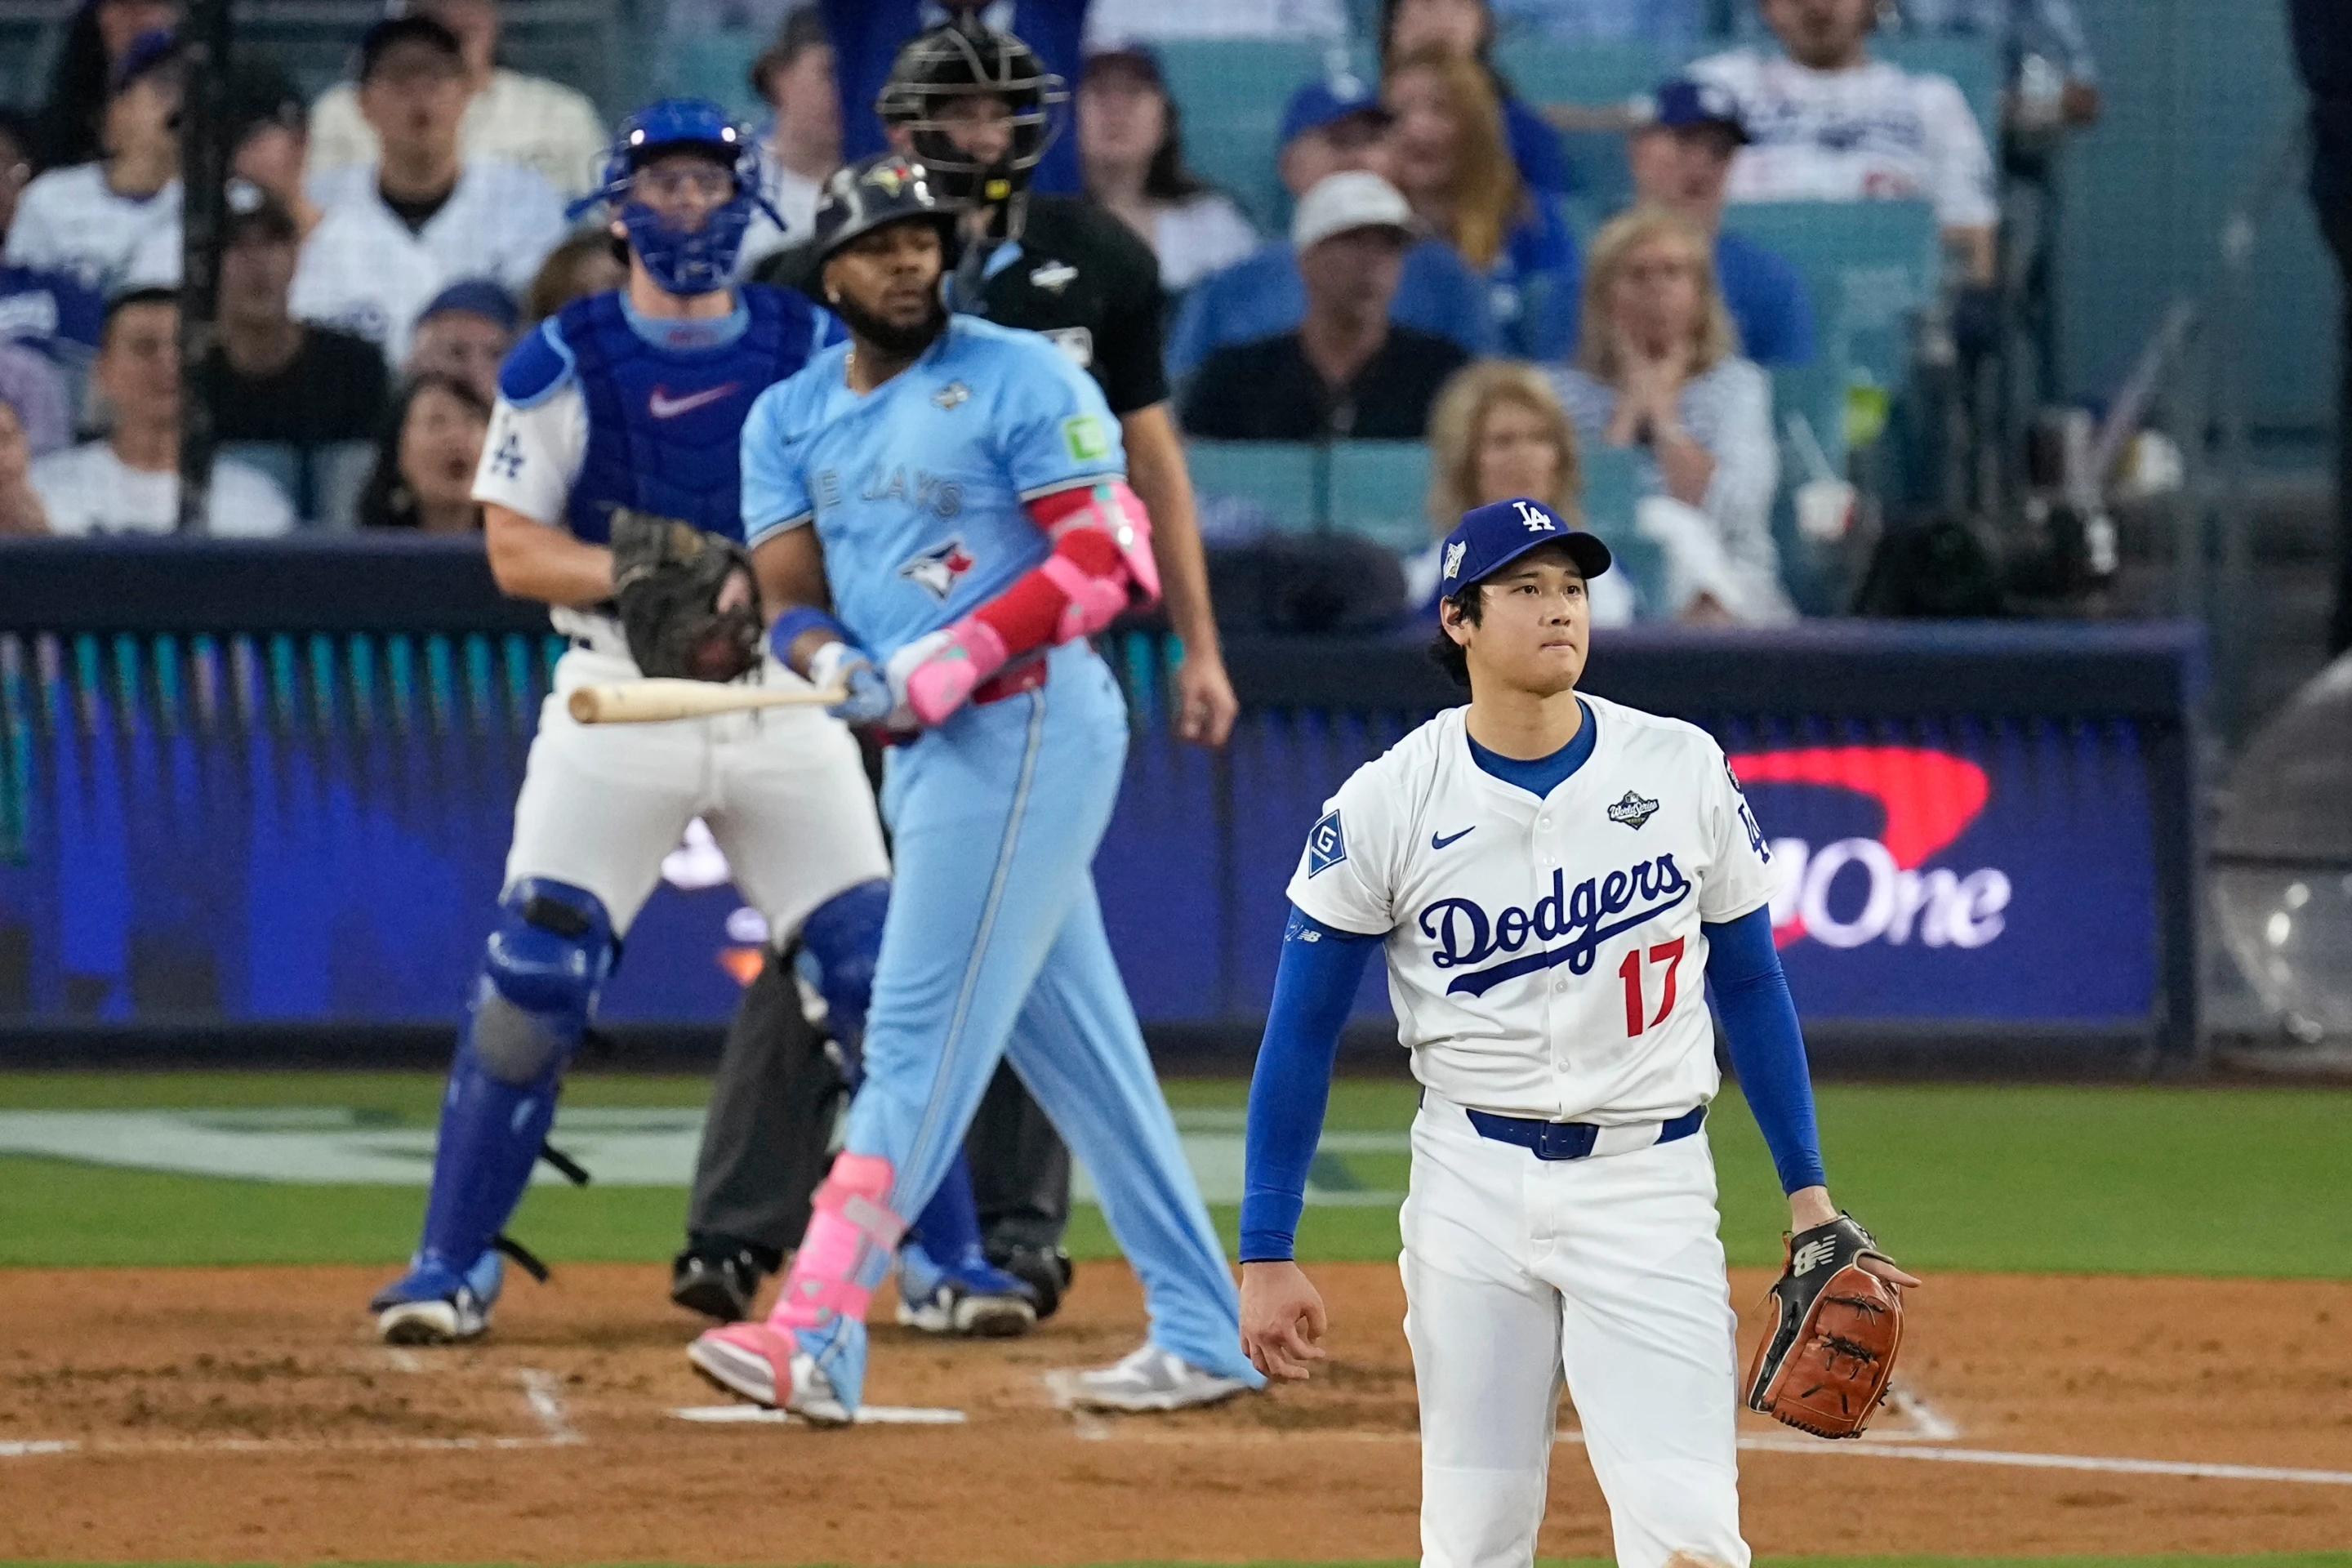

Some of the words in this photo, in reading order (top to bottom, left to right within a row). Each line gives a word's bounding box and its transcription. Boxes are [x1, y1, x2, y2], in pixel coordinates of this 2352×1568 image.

[1512, 501, 1556, 532] LA
[1317, 826, 1337, 853] G
[1419, 853, 1691, 988] Dodgers
[1619, 935, 1685, 1038] 17
